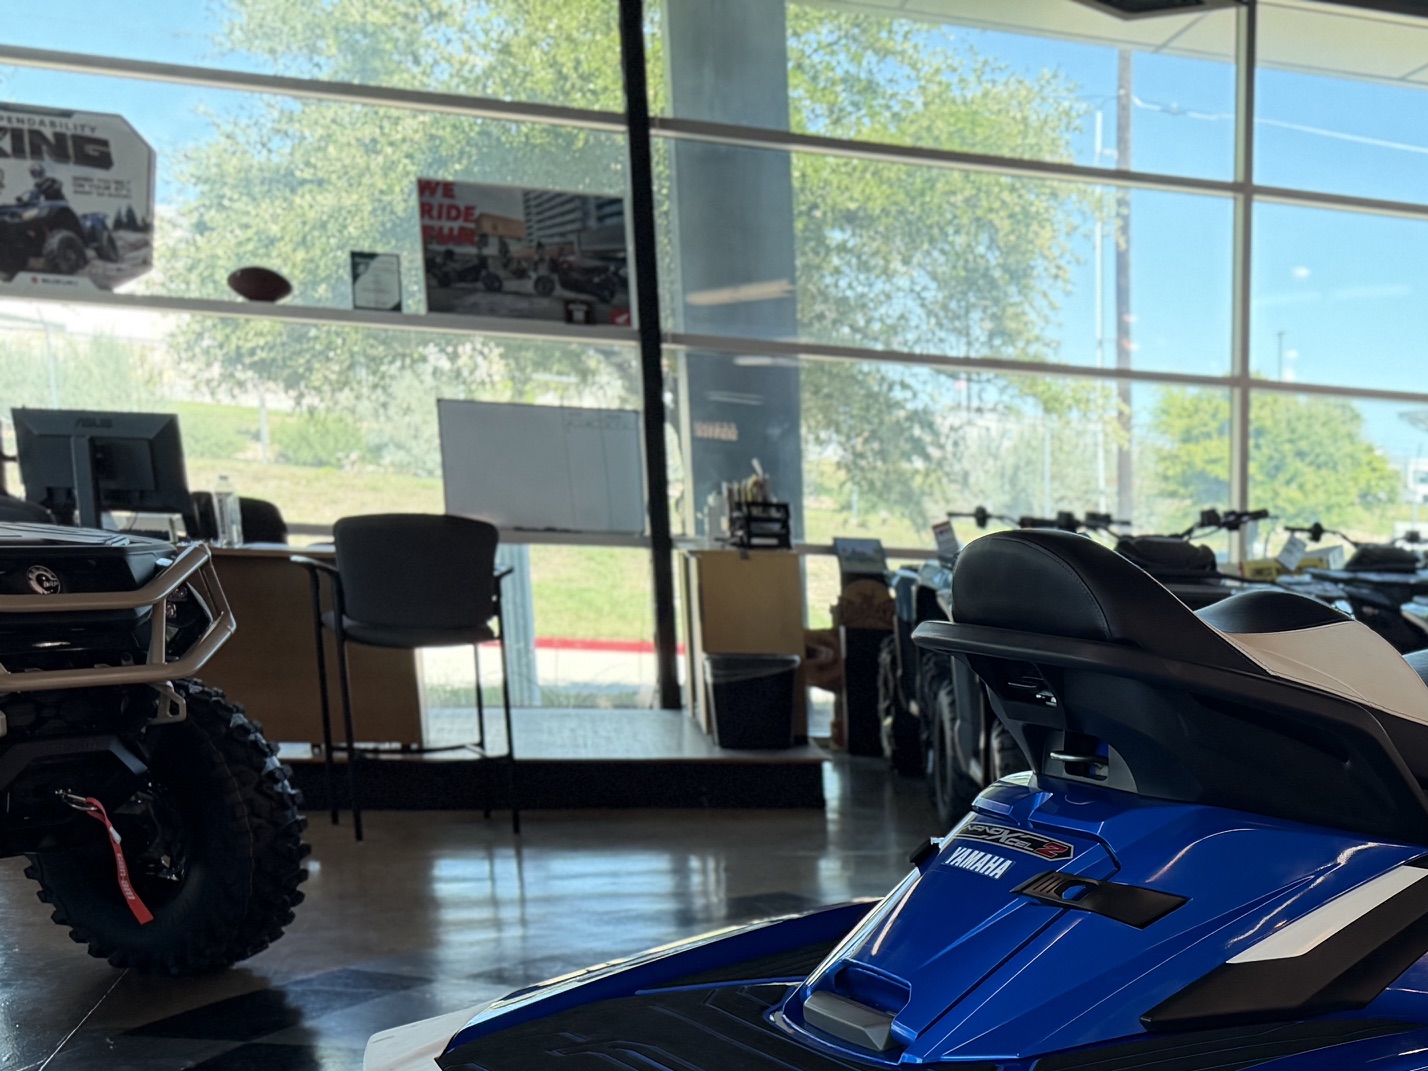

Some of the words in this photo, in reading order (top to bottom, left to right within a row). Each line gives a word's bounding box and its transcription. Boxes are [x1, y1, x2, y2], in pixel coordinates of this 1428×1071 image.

[418, 179, 455, 199] WE
[420, 202, 477, 223] RIDE
[945, 846, 1014, 880] YAMAHA
